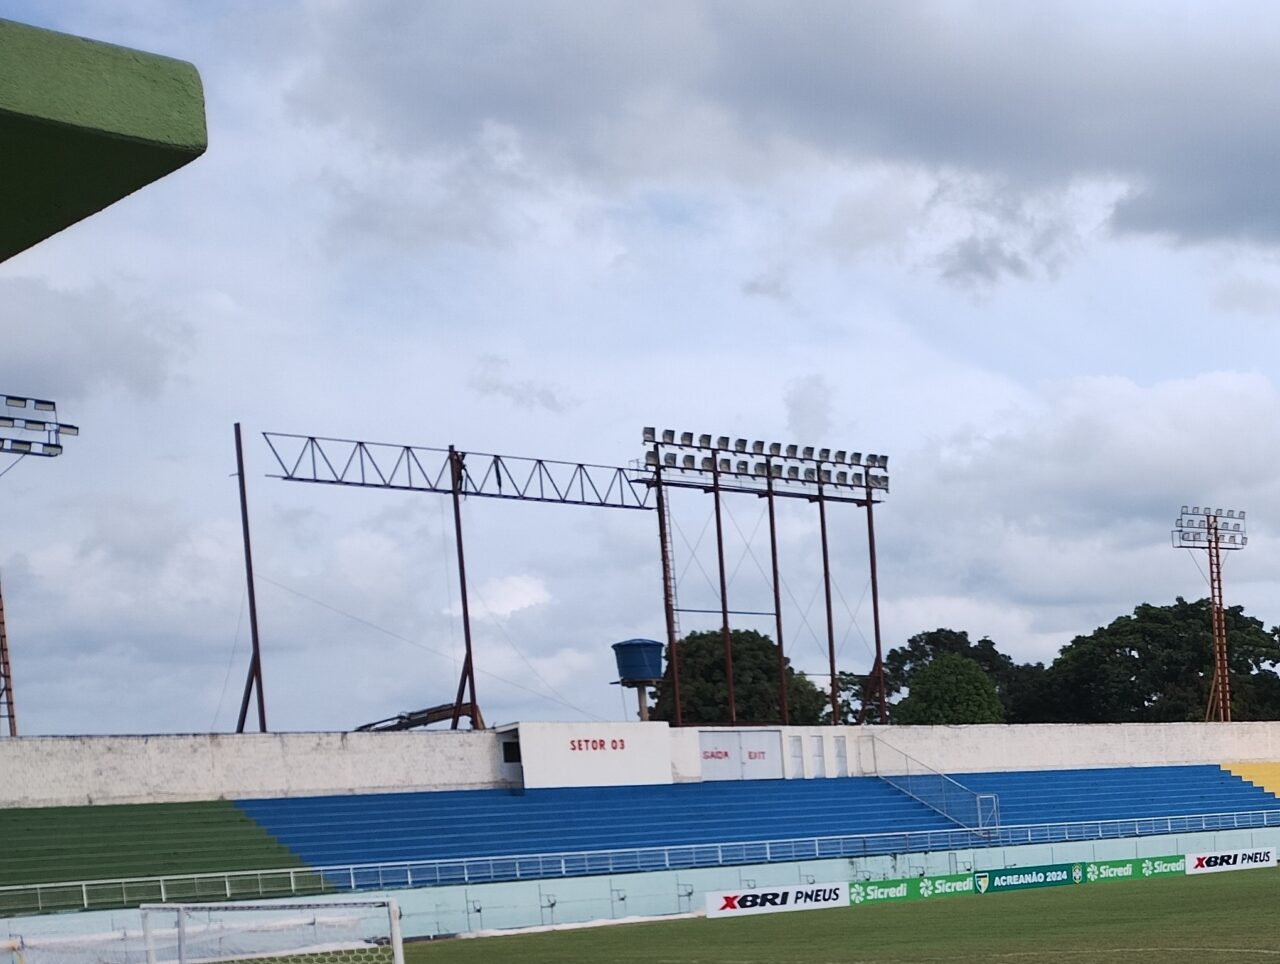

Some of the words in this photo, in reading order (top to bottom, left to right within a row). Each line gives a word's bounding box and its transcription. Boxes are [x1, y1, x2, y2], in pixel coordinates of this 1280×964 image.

[570, 739, 606, 750] SETOR
[611, 739, 625, 750] 03
[748, 751, 766, 760] EXIT
[1153, 860, 1185, 873] Sicredi
[1193, 853, 1238, 869] XBRI
[1241, 851, 1271, 864] PNEUS
[1099, 864, 1133, 877] Sicredi
[934, 878, 974, 893] Sicredi
[993, 871, 1044, 887] ACREANÃO
[1046, 870, 1068, 881] 2024
[866, 883, 908, 899] Sicredi
[719, 891, 789, 911] XBRI
[794, 887, 840, 905] PNEUS
